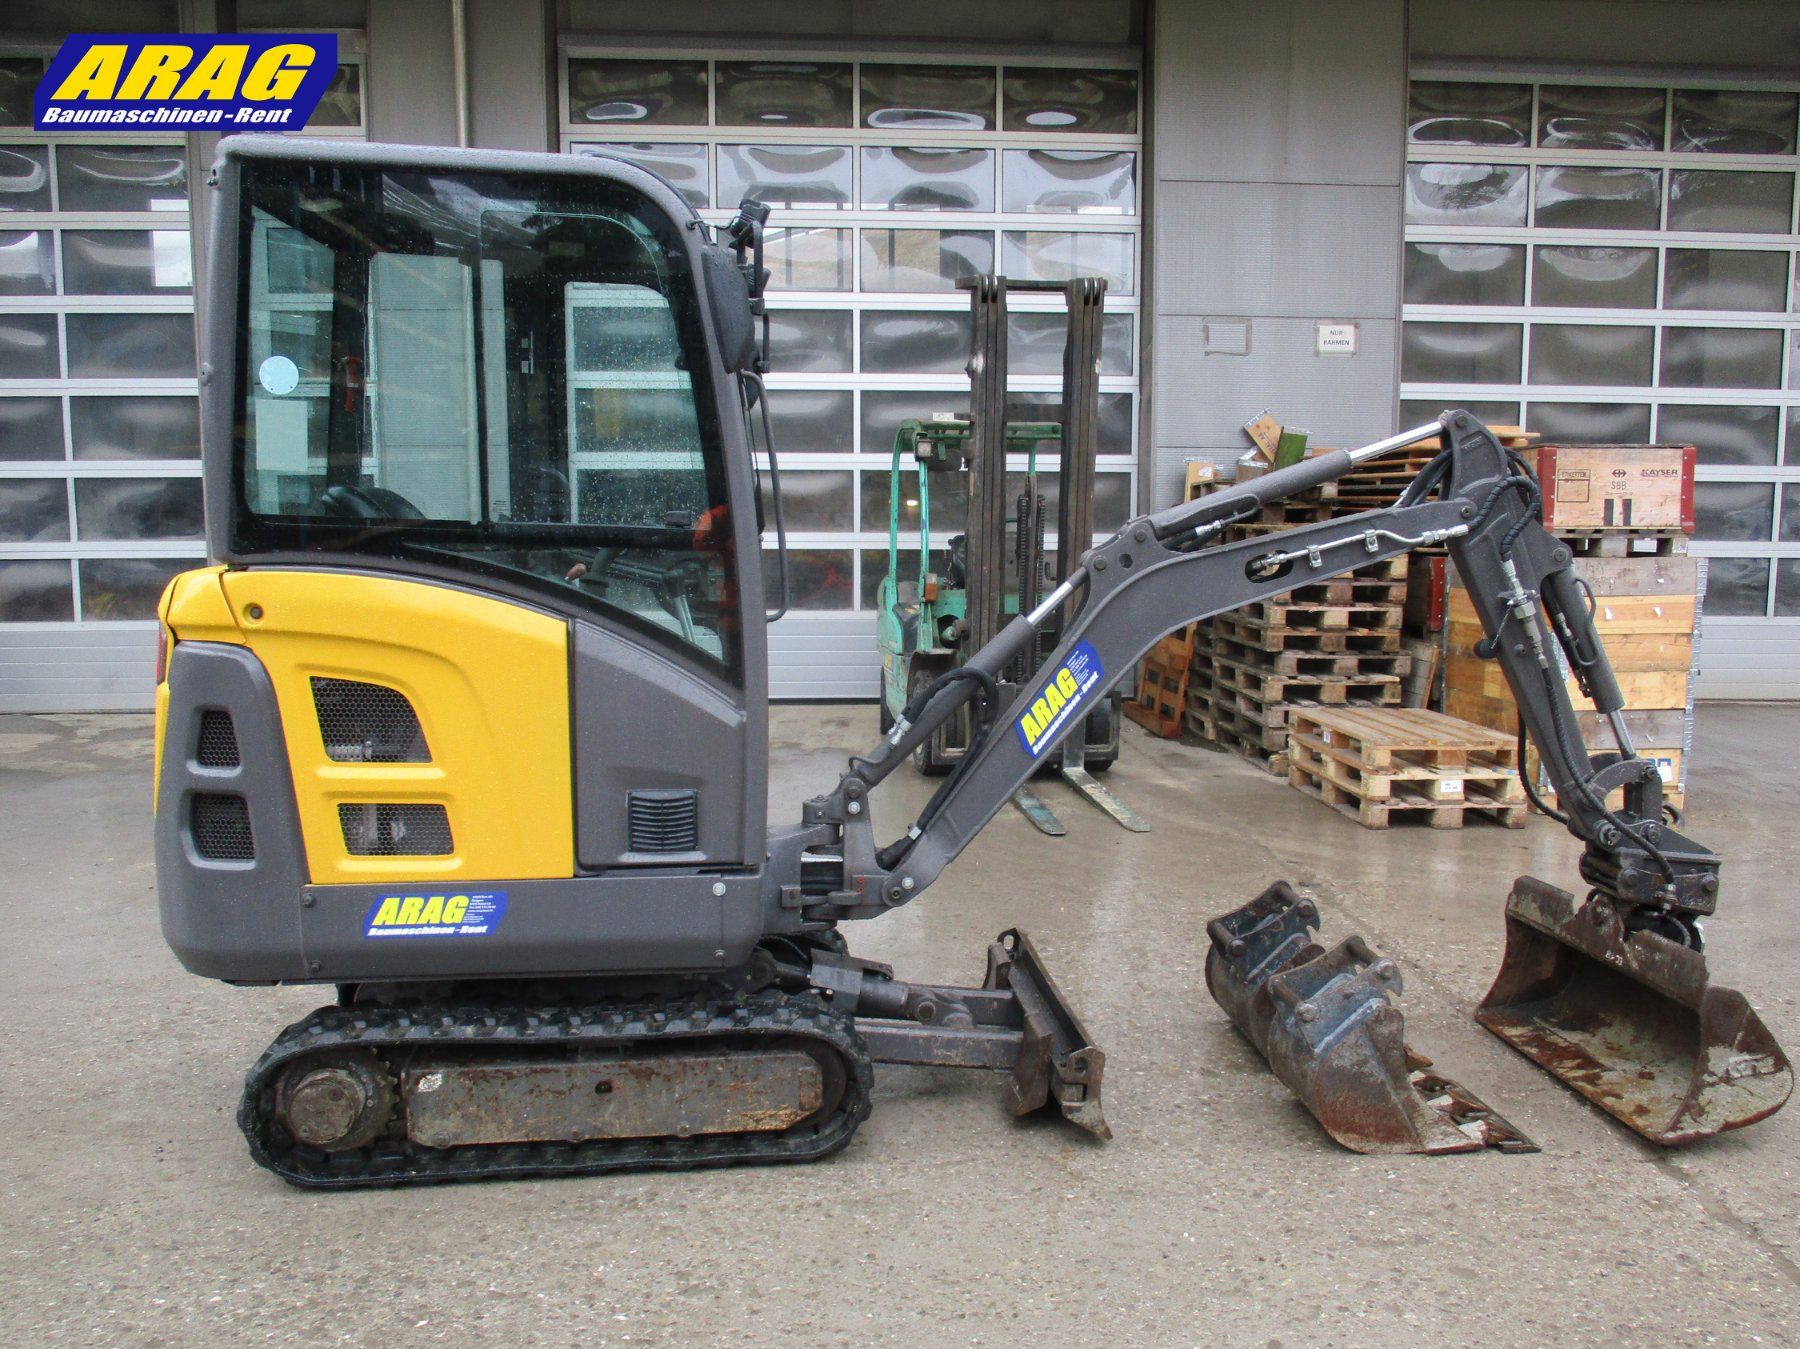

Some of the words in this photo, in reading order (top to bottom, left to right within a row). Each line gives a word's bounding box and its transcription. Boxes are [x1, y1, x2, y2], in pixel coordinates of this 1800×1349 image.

[1640, 468, 1679, 477] KAYSER
[1610, 480, 1627, 491] SBB
[1021, 667, 1079, 747] ARAG
[372, 895, 469, 926] ARAG
